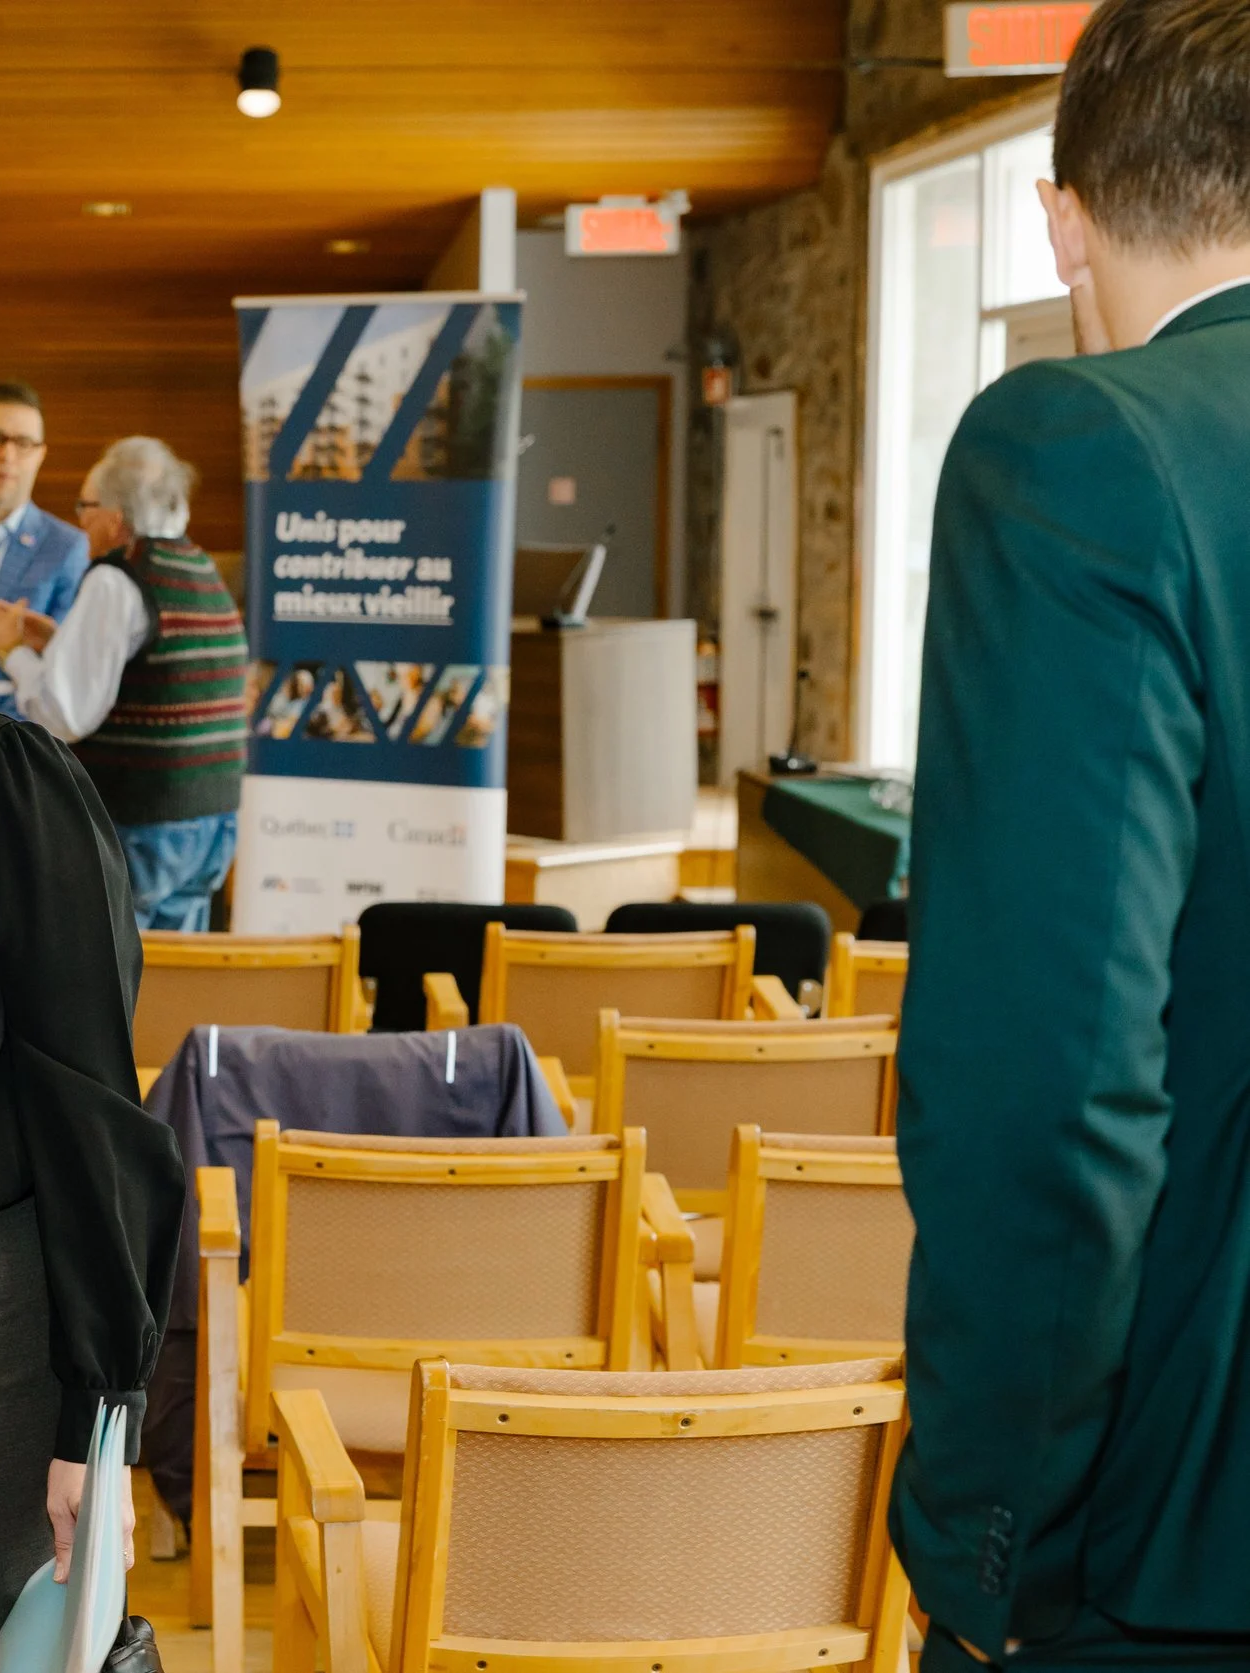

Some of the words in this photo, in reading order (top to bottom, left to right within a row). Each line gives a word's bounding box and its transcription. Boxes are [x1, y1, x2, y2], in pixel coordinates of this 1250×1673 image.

[275, 510, 337, 543] Unis
[337, 518, 406, 549] pour
[273, 547, 414, 581] contribuer
[415, 556, 452, 582] au
[273, 583, 363, 616] mieux
[364, 584, 455, 618] vieillir
